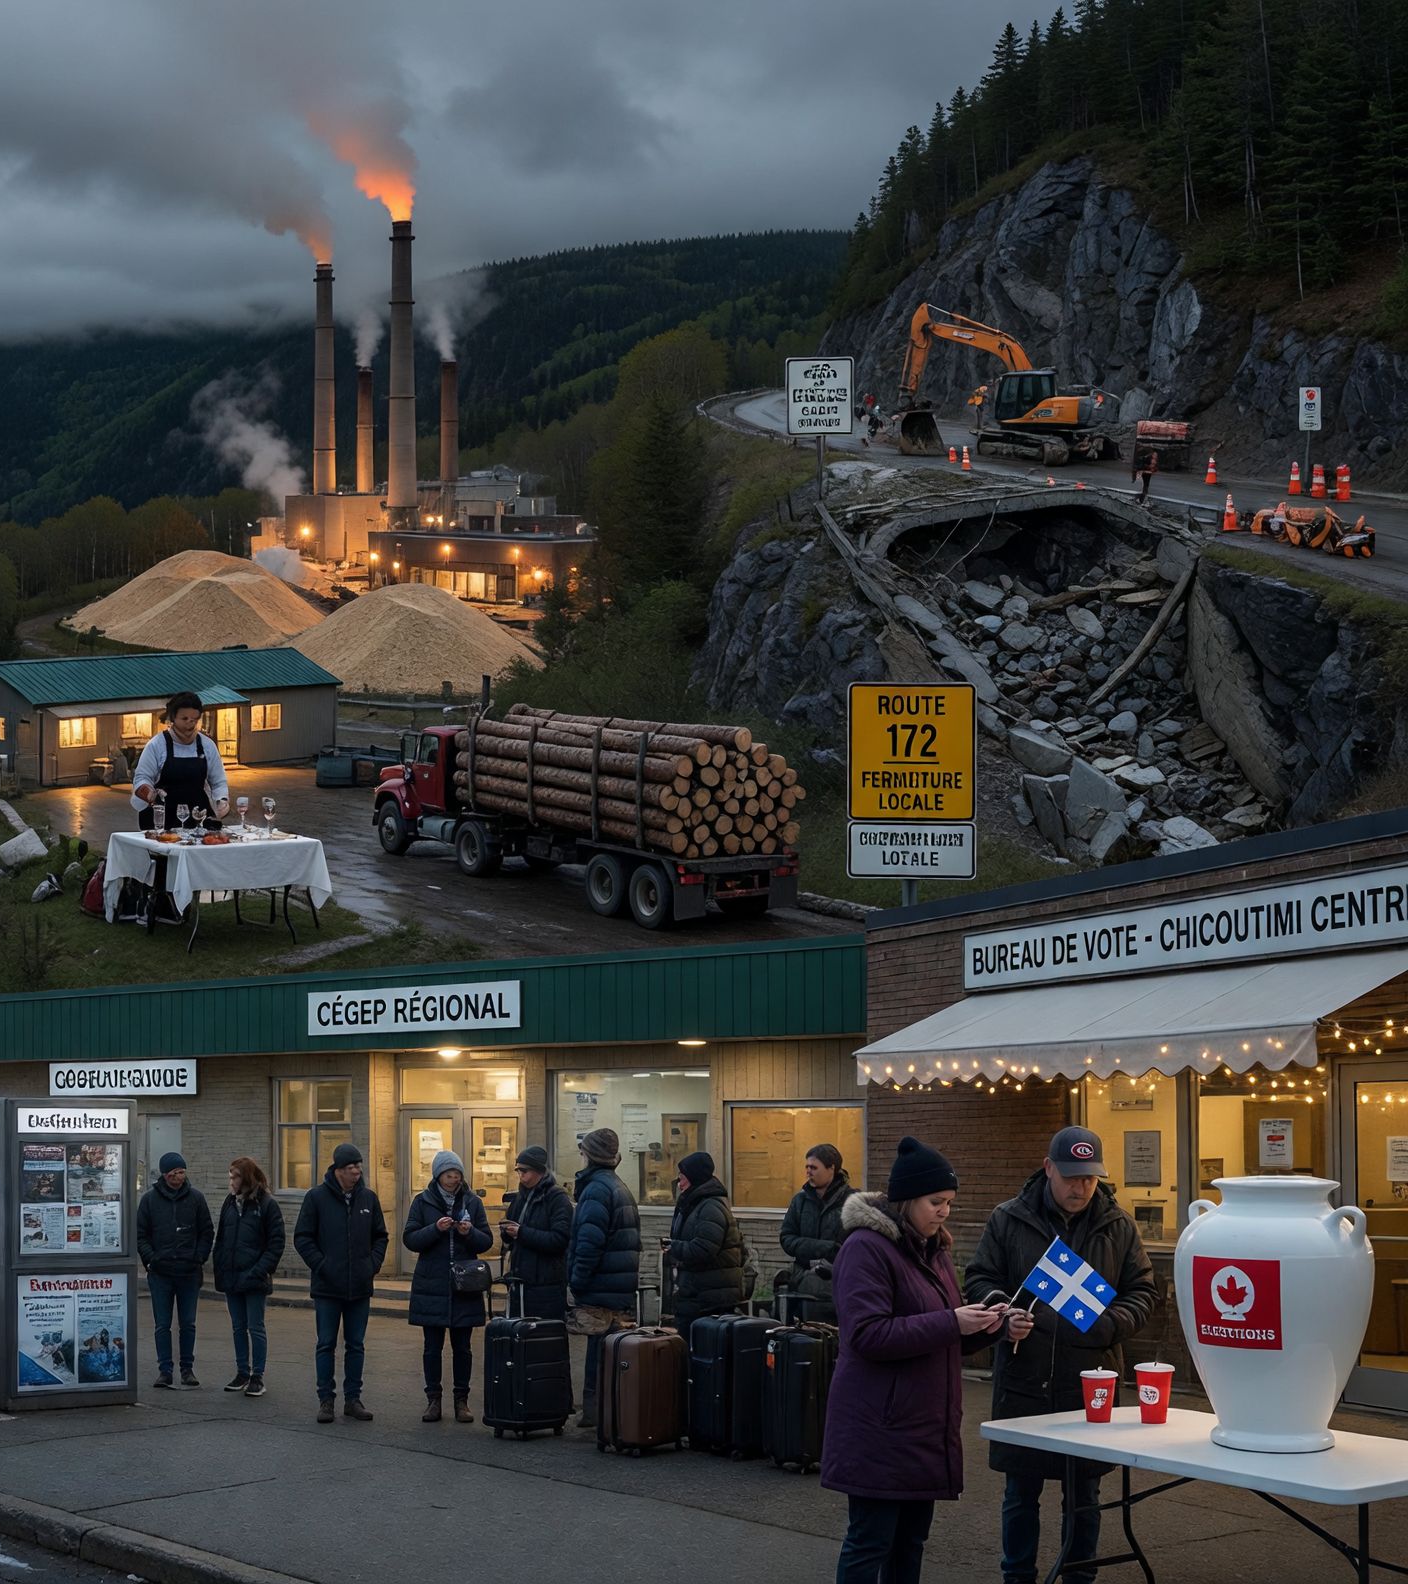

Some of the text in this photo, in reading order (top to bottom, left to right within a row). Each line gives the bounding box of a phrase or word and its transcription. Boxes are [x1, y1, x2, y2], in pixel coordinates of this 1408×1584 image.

[878, 695, 946, 716] ROUTE
[886, 723, 937, 758] 172
[879, 793, 945, 811] LOCALE
[972, 937, 1045, 976] BUREAU
[1052, 933, 1078, 966] DE
[1083, 924, 1138, 962] VOTE
[1159, 899, 1302, 952] CHICOUTIMI
[1310, 885, 1408, 933] CENTR
[317, 991, 511, 1027] CÉGEP RÉGIONAL
